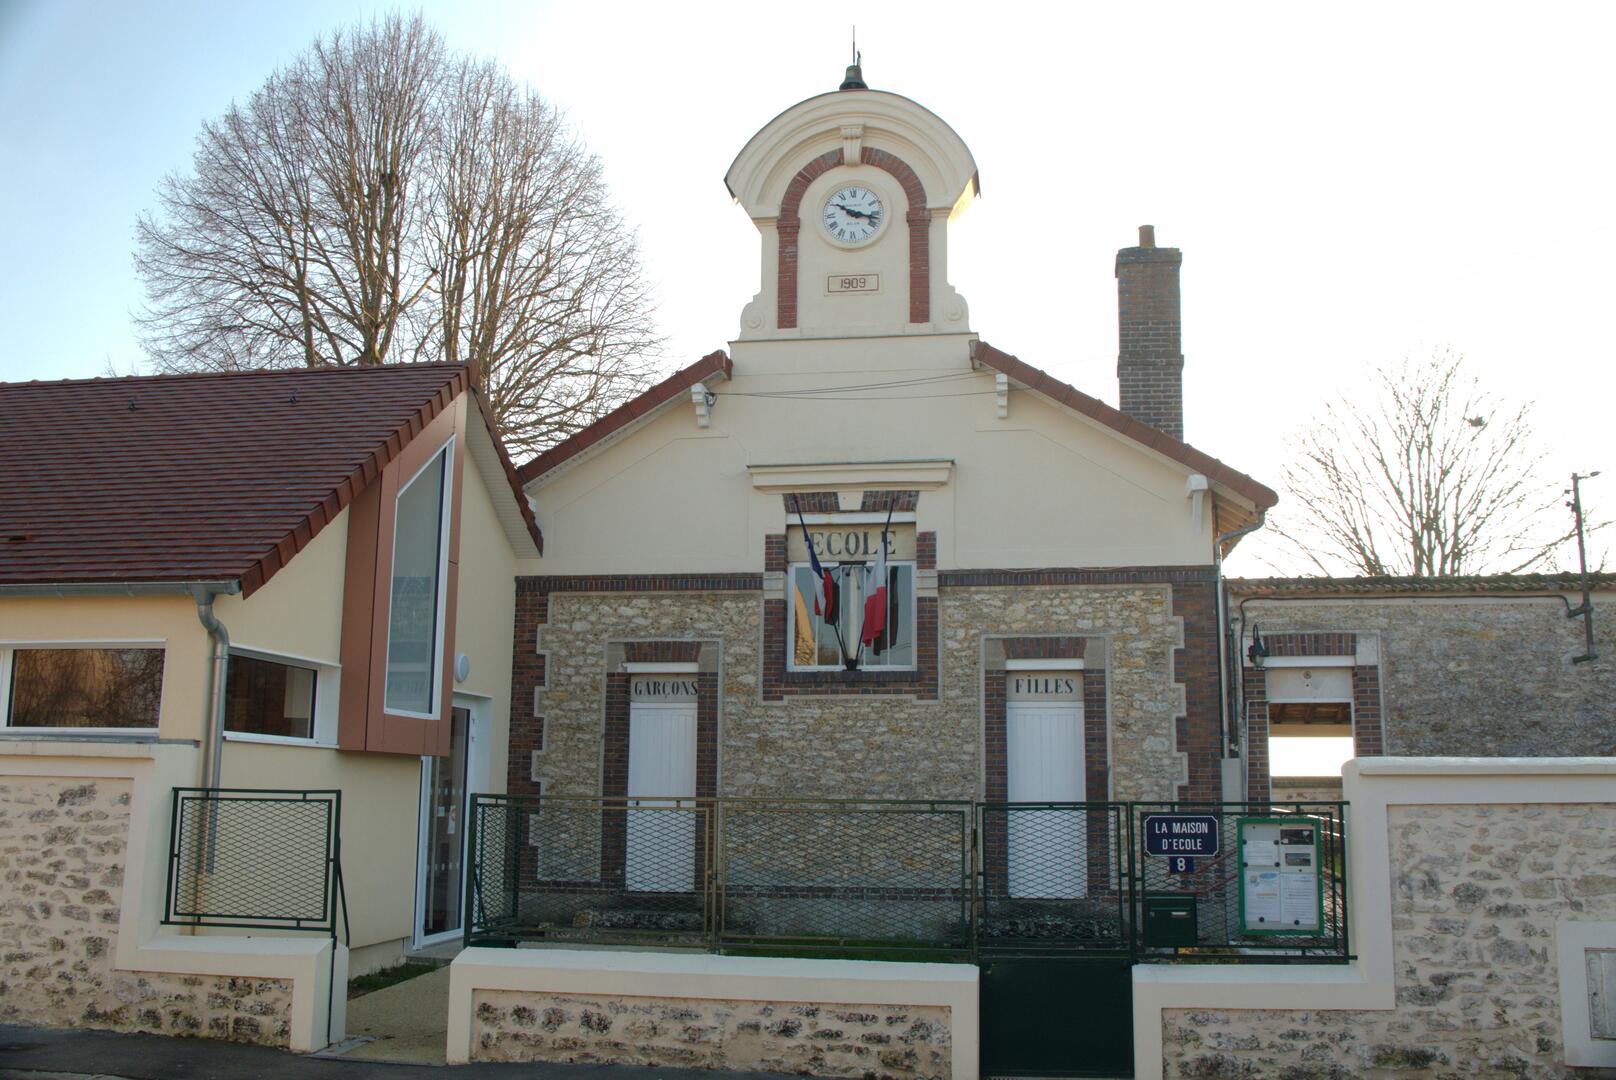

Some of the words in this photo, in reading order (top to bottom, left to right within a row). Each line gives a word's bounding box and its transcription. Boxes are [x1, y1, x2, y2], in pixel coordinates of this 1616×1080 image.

[840, 277, 866, 289] 1909
[808, 530, 897, 556] ECOLE
[634, 681, 698, 699] GARÇONS
[1155, 822, 1168, 834] LA
[1172, 822, 1209, 834] MAISON
[1162, 838, 1203, 850] D'ECOLE
[1177, 857, 1186, 872] 8
